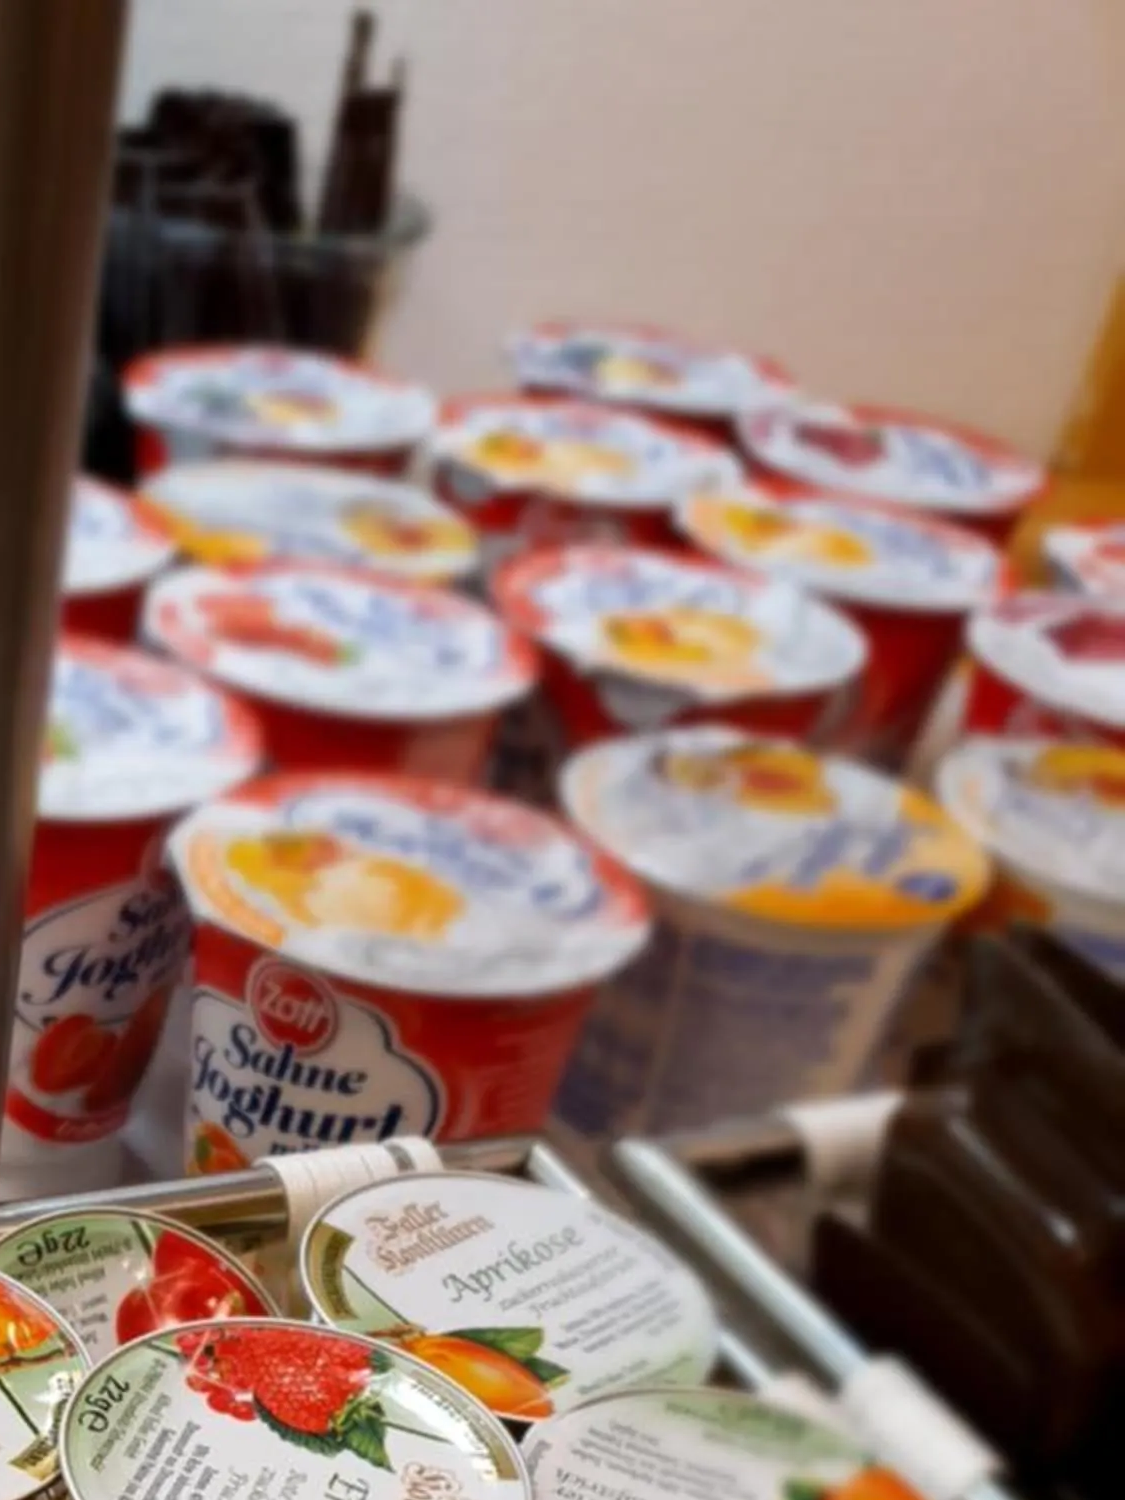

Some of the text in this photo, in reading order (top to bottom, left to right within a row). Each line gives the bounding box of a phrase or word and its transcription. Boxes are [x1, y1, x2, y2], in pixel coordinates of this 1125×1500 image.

[193, 1036, 405, 1142] Joghurt
[223, 1023, 367, 1096] Sahne
[442, 1223, 587, 1304] Aprikose
